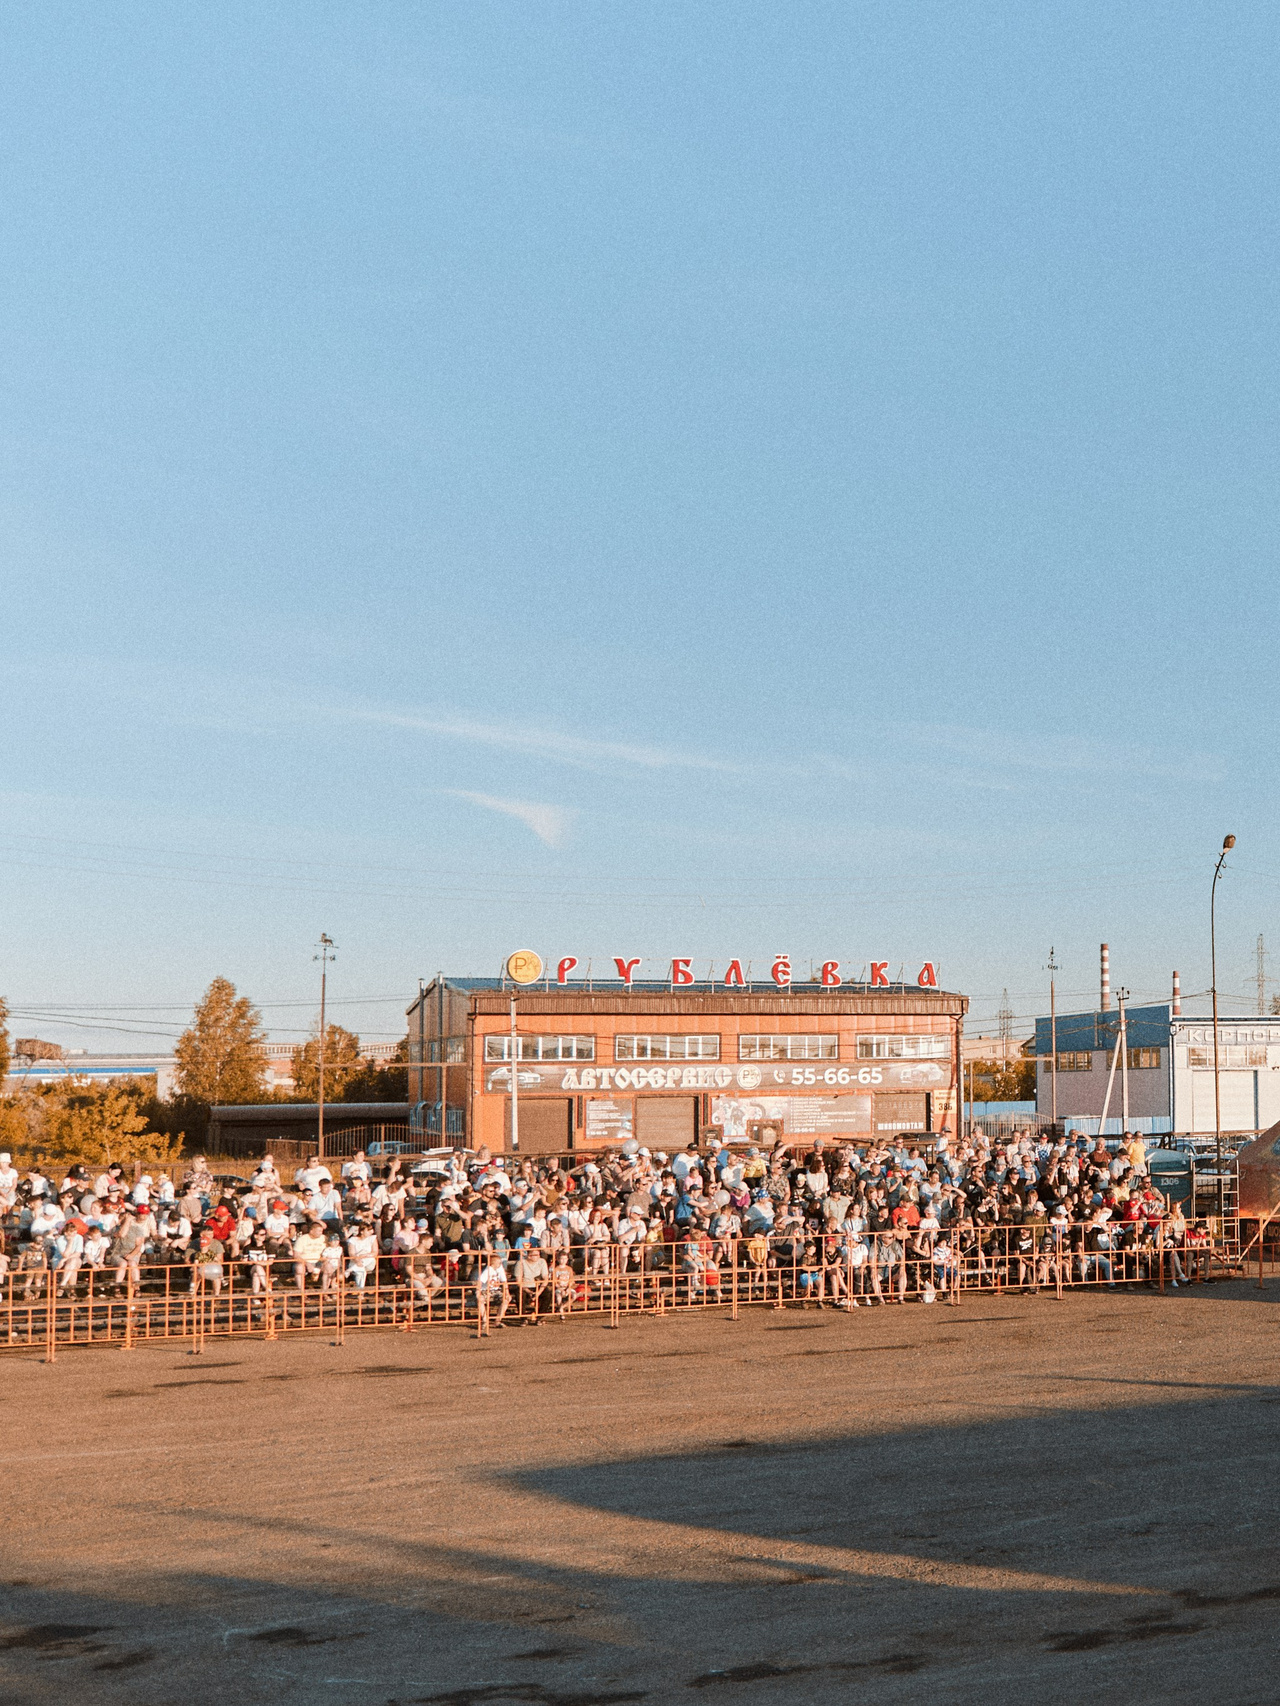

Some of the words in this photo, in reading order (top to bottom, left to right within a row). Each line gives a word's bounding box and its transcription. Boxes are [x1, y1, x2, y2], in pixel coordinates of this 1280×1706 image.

[557, 954, 938, 988] РУБЛЁВКА
[562, 1067, 733, 1090] АВТОСЕРВИС
[791, 1067, 883, 1085] 55-66-65
